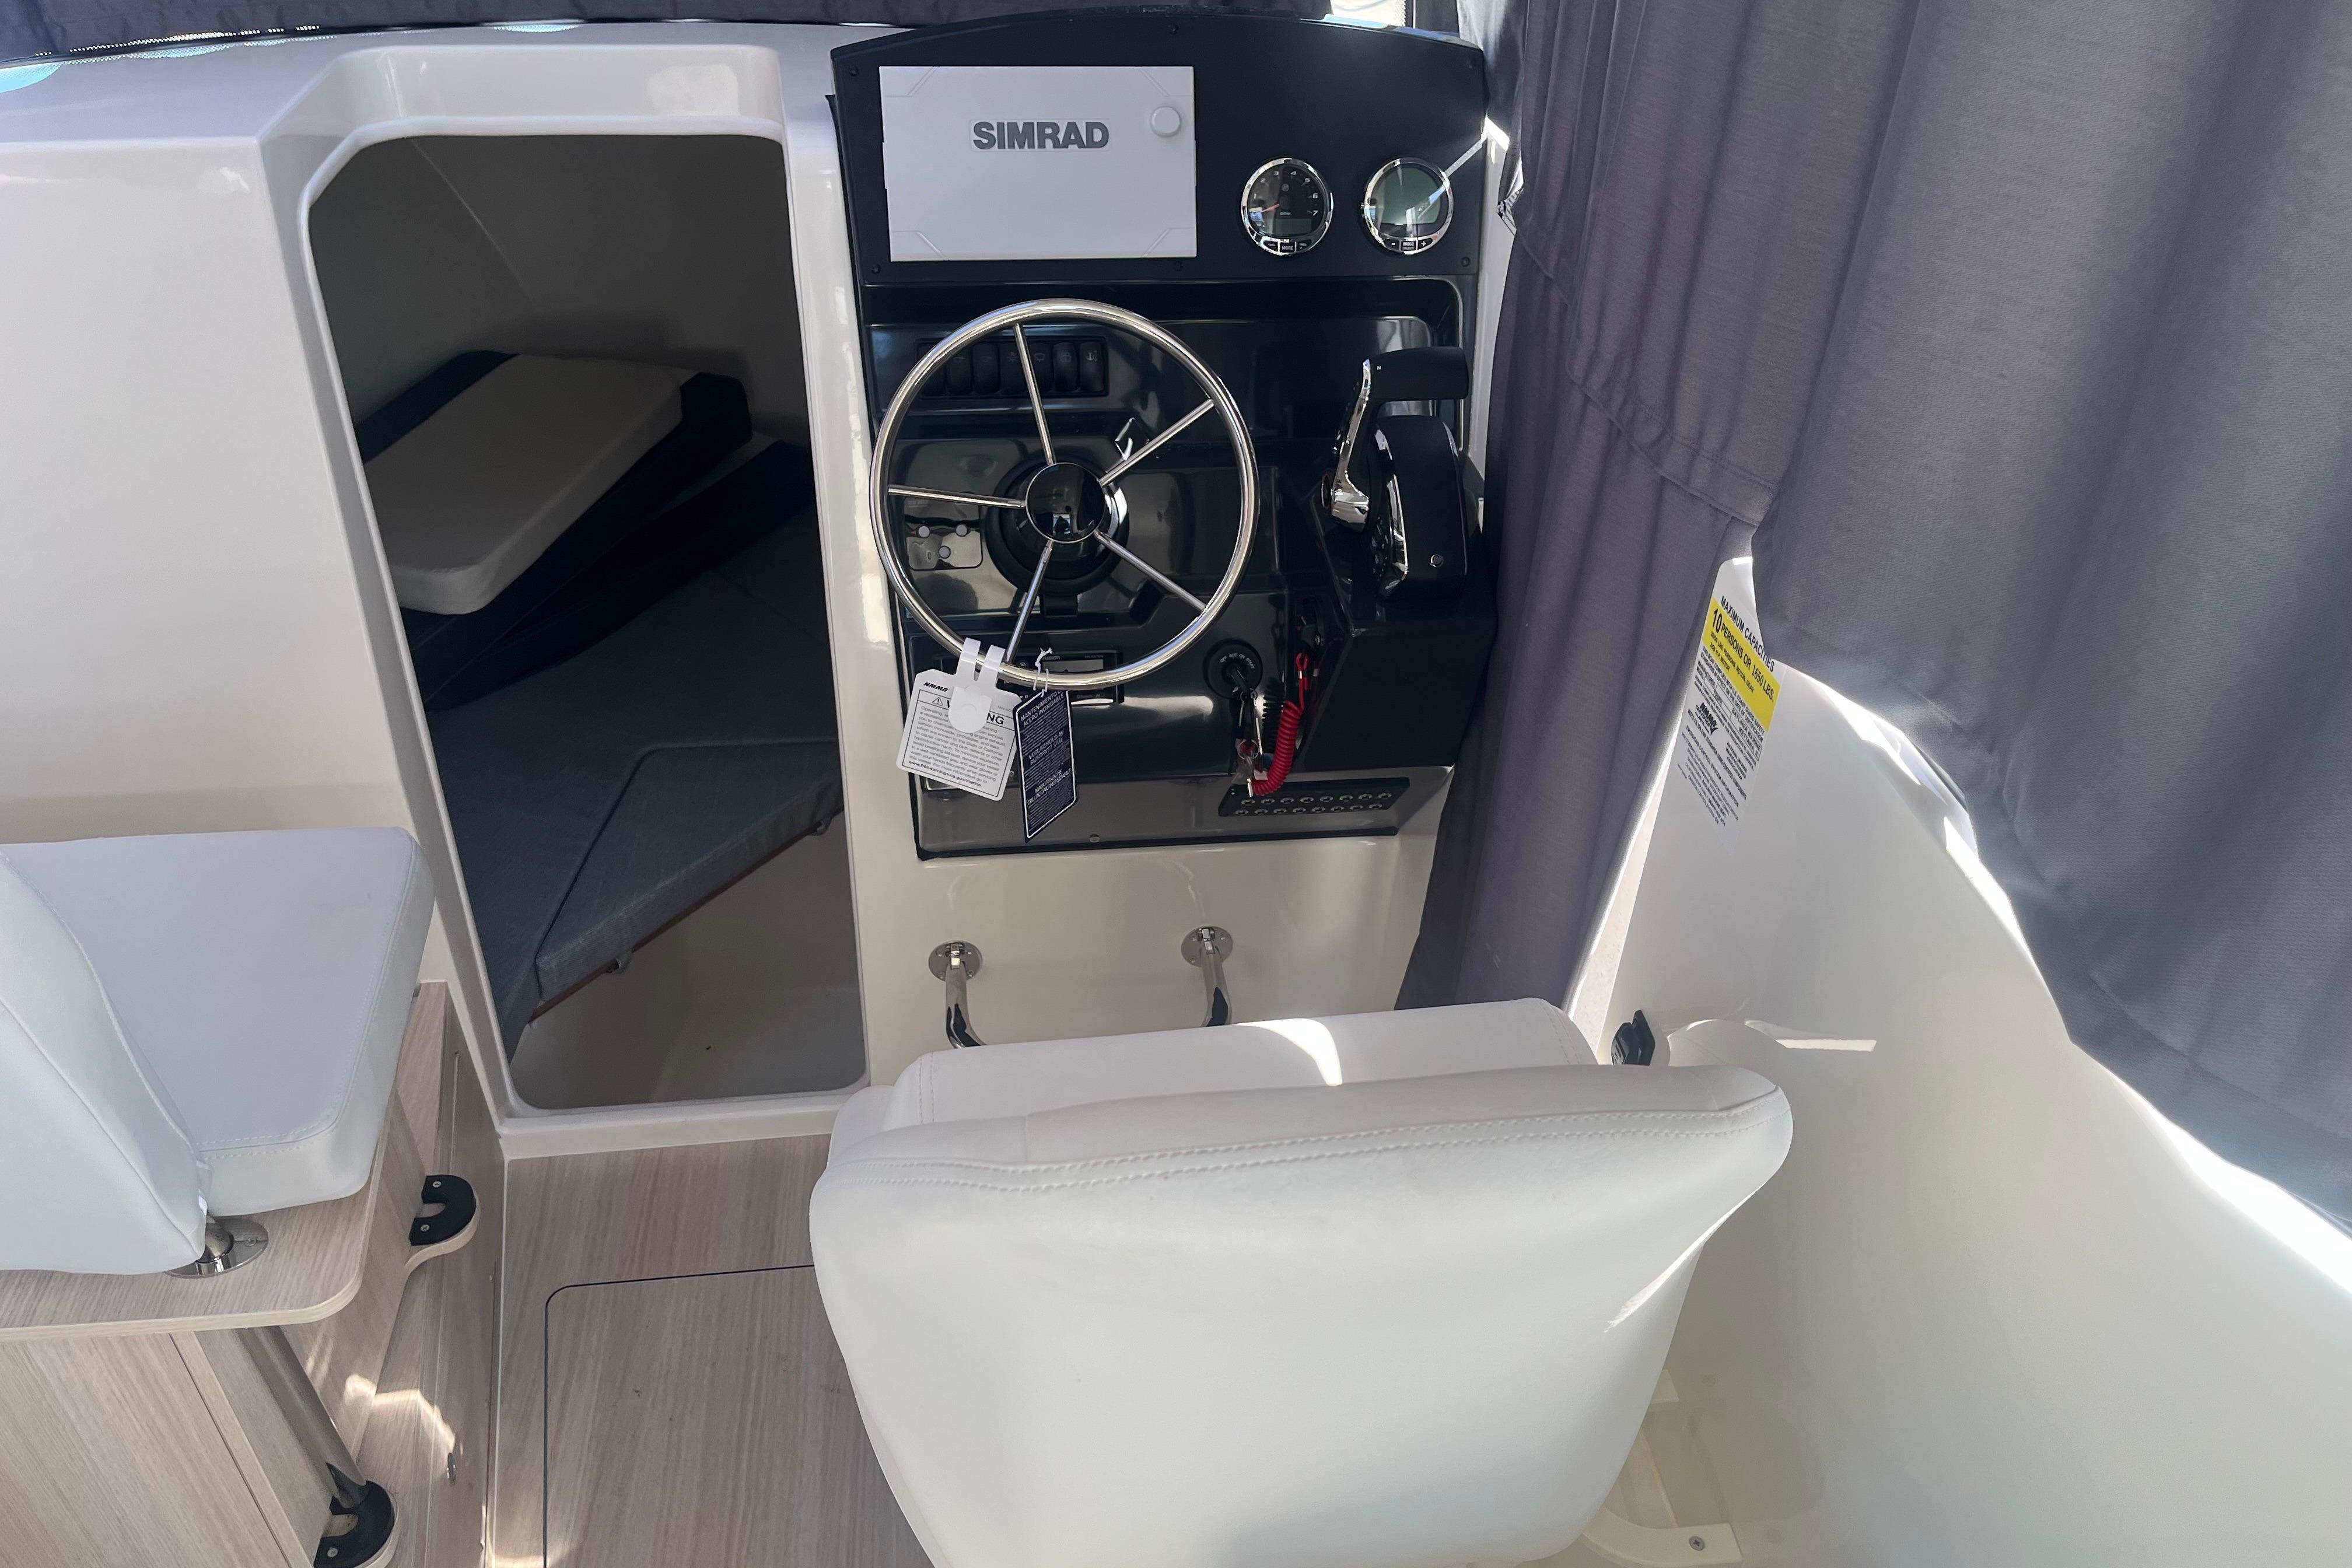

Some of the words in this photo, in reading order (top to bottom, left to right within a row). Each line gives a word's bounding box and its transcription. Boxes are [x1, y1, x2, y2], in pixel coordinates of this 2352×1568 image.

[973, 121, 1110, 149] SIMRAD
[1721, 596, 1744, 632] MAXIMUM
[1713, 609, 1722, 633] 10
[1721, 624, 1743, 658] PERSONS
[1744, 654, 1751, 670] OR
[1752, 665, 1763, 686] 1650
[1763, 680, 1774, 701] LBS.
[1024, 713, 1038, 727] ACERO
[1038, 693, 1063, 715] INOXIDABLE
[1732, 708, 1748, 732] BAYLINER
[1748, 731, 1760, 751] MARINE
